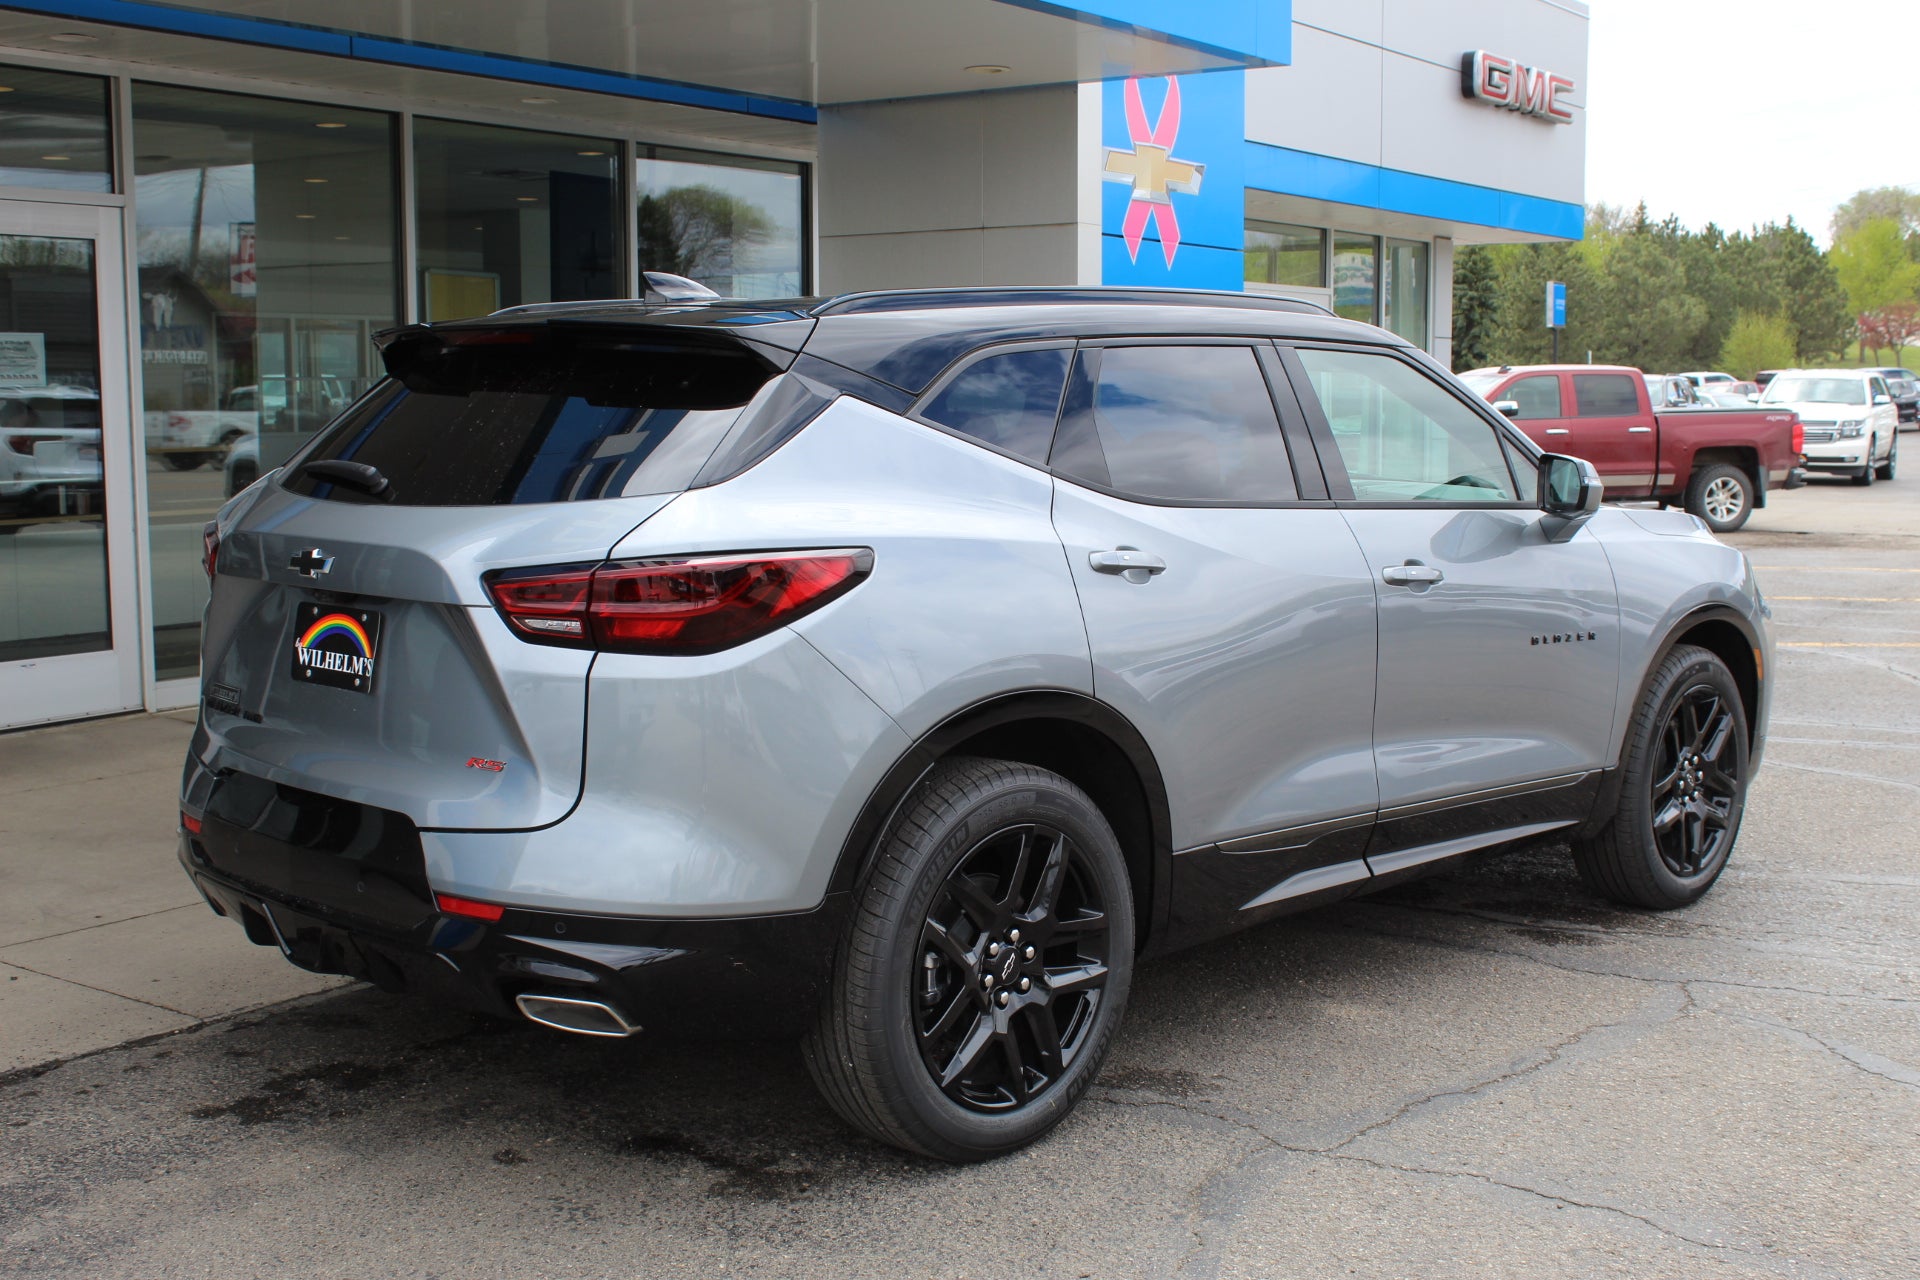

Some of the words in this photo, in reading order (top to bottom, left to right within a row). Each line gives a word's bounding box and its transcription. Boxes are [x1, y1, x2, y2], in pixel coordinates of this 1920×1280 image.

[1462, 49, 1576, 125] GMC
[1530, 631, 1597, 645] BLAZER
[297, 646, 374, 677] WILHELM'S
[464, 757, 507, 772] RS
[909, 825, 967, 920] MICHELIN
